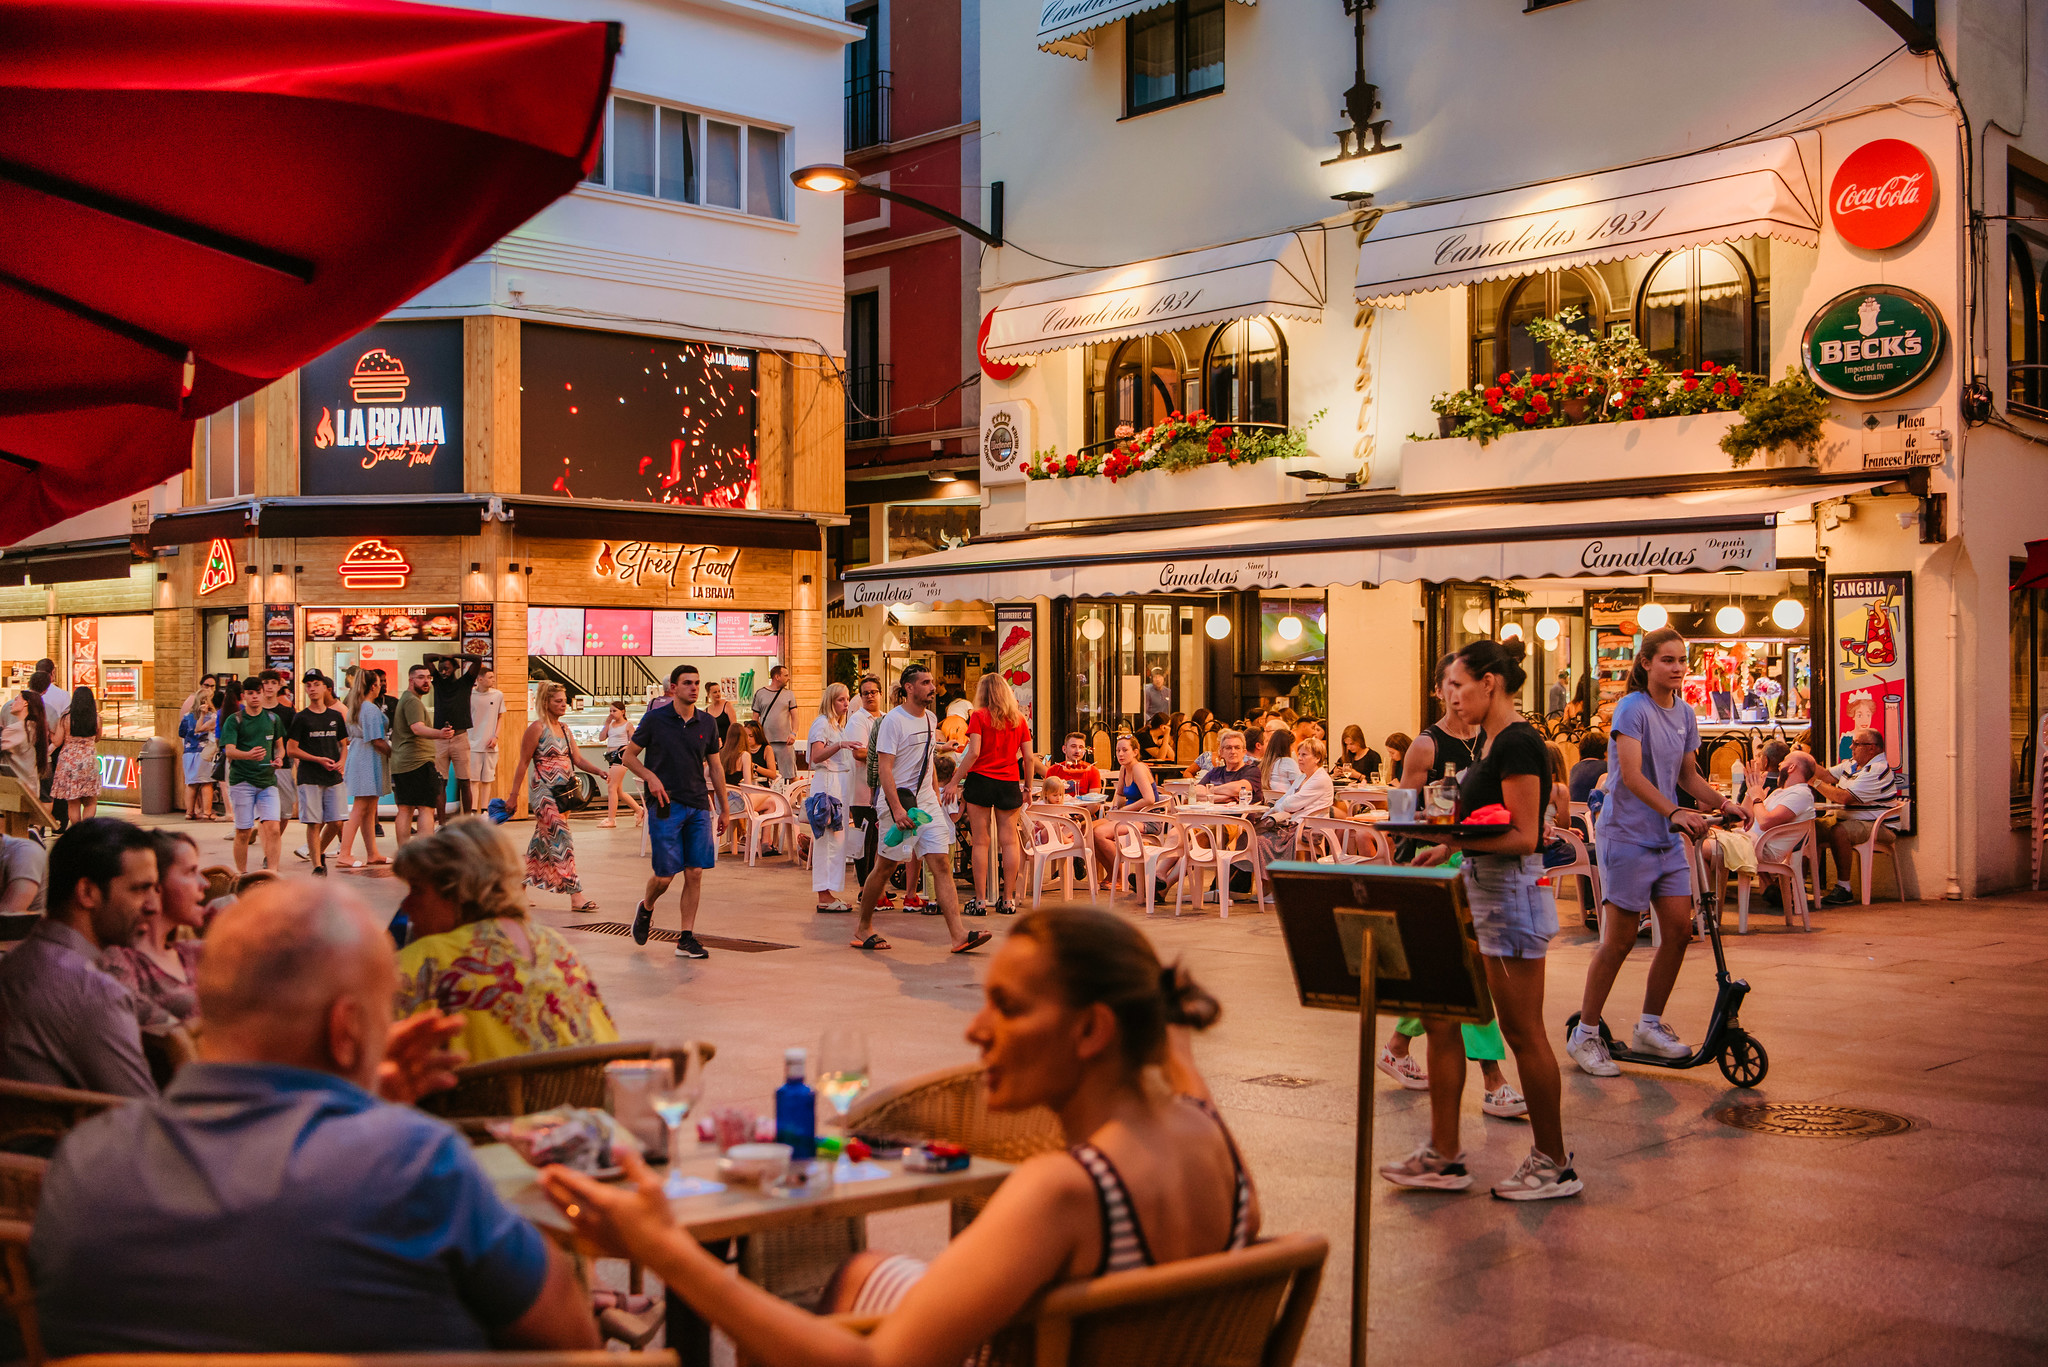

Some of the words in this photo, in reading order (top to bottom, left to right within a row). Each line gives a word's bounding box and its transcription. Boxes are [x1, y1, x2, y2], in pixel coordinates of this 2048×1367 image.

[1836, 172, 1925, 215] Coca-Cola
[1434, 219, 1576, 266] Canaletas
[1586, 206, 1666, 241] 1931
[1042, 297, 1141, 333] Canaletas
[1146, 288, 1204, 316] 1931
[715, 352, 725, 365] LA
[726, 353, 750, 368] BRAVA
[1844, 365, 1875, 374] Imported
[1876, 362, 1893, 370] from
[1853, 372, 1885, 382] Germany
[337, 408, 366, 446] LA
[369, 406, 446, 446] BRAVA
[1897, 414, 1925, 431] Plaça
[1905, 434, 1916, 448] de
[361, 436, 410, 469] Street
[407, 441, 438, 468] Food
[995, 462, 1010, 472] UNTER
[1009, 450, 1018, 465] DEN
[1863, 454, 1902, 468] Francesc
[1903, 449, 1941, 466] Piferrer
[1580, 540, 1697, 569] Canaletas
[1706, 537, 1746, 549] Depuis
[1721, 548, 1753, 560] 1931
[616, 541, 685, 588] Street
[689, 546, 742, 586] Food
[1159, 563, 1240, 587] Canaletas
[1246, 561, 1265, 571] Since
[1257, 570, 1279, 580] 1931
[692, 586, 704, 599] LA
[705, 587, 735, 600] BRAVA
[854, 582, 914, 603] Canaletas
[926, 588, 942, 597] 1931
[1833, 580, 1886, 597] SANGRIA
[340, 607, 357, 616] YOUR
[407, 607, 427, 616] HERE!
[1022, 611, 1032, 619] CAKE
[718, 616, 740, 625] WAFFLES
[832, 625, 864, 644] GRILL
